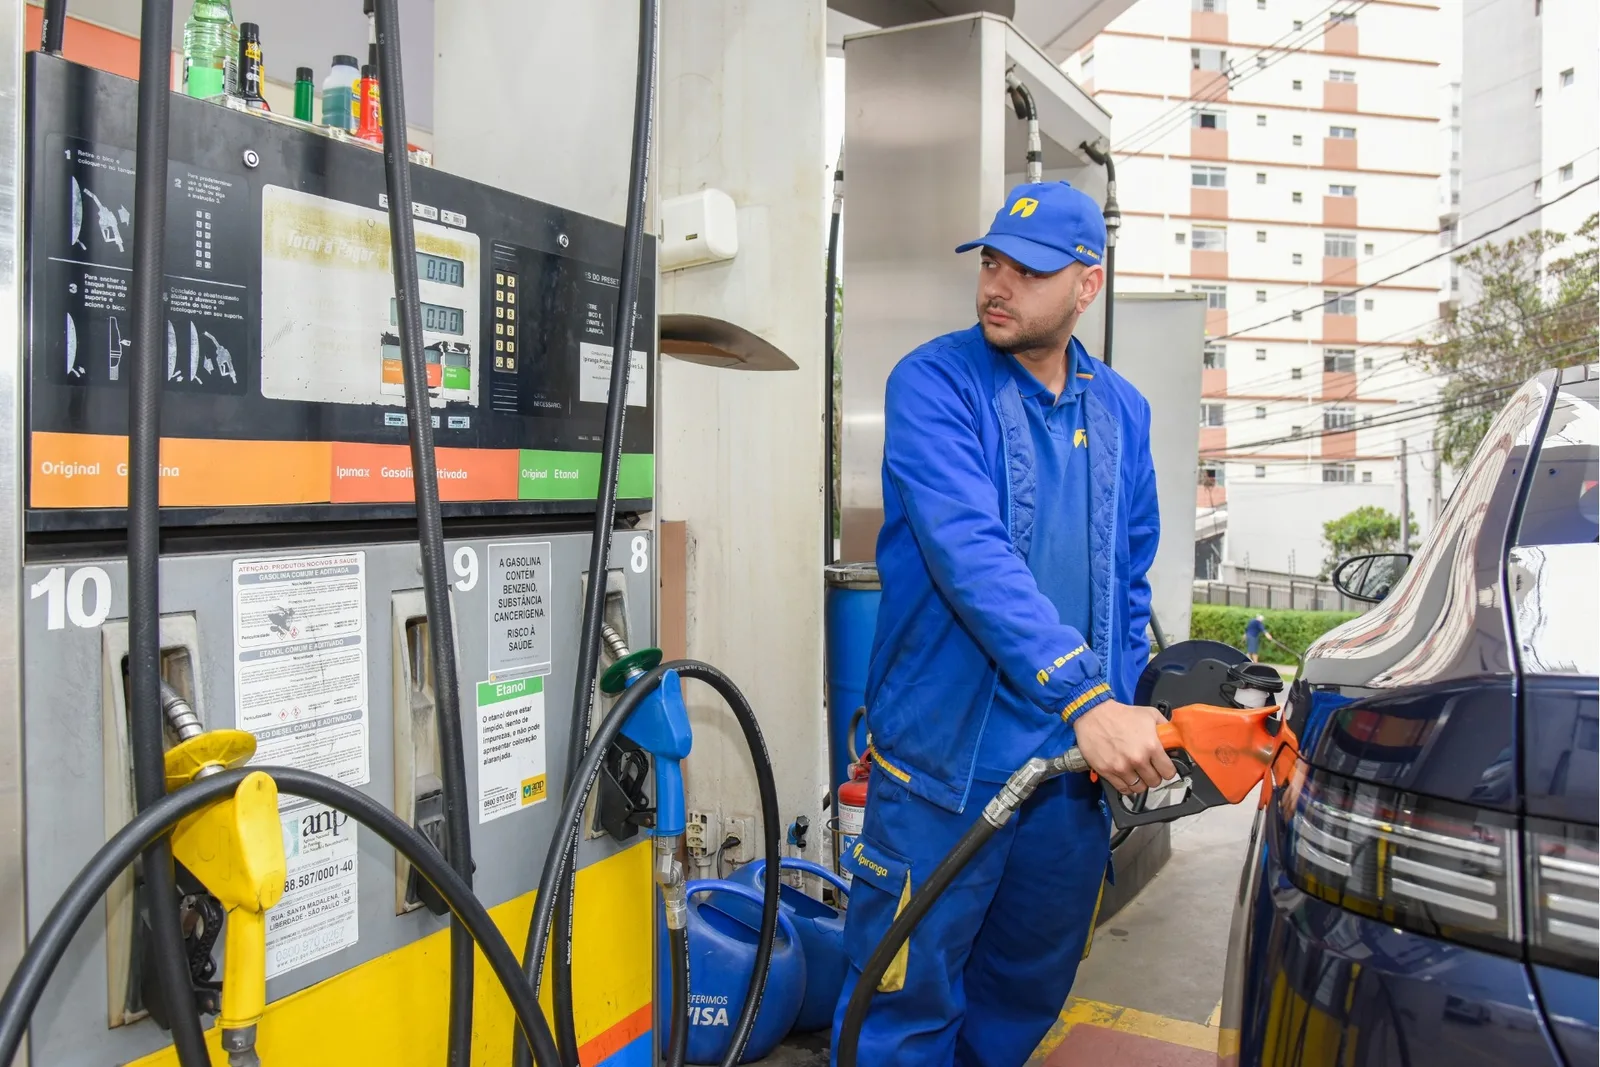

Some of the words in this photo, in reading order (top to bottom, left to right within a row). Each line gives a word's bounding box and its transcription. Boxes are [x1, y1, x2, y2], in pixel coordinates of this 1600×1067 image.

[64, 150, 70, 160] 1
[174, 178, 182, 188] 2
[427, 260, 458, 284] 0.00
[69, 283, 78, 294] 3
[426, 308, 458, 332] 0.00
[41, 461, 100, 478] Original
[336, 466, 370, 480] Ipimax
[381, 466, 414, 478] Gasoli
[437, 467, 468, 480] itivada
[522, 468, 548, 480] Original
[554, 468, 579, 479] Etanol
[631, 536, 648, 574] 8
[499, 558, 504, 568] A
[506, 556, 542, 568] GASOLINA
[258, 572, 290, 581] GASOLINA
[292, 570, 314, 578] COMUM
[453, 546, 478, 592] 9
[506, 568, 535, 580] CONTÉM
[31, 566, 112, 630] 10
[498, 594, 542, 608] SUBSTÂNCIA
[508, 628, 528, 638] RISCO
[530, 624, 536, 636] À
[260, 648, 284, 657] ETANOL
[285, 644, 308, 654] COMUM
[508, 638, 534, 651] SAÚDE.
[496, 680, 526, 697] Etanol
[488, 712, 504, 722] etanol
[506, 710, 518, 718] deve
[519, 706, 532, 714] estar
[272, 727, 292, 738] DIESEL
[517, 727, 527, 735] não
[528, 723, 540, 733] pode
[483, 742, 512, 755] apresentar
[512, 734, 538, 746] coloração
[532, 780, 544, 790] anp
[302, 810, 348, 836] anp
[270, 914, 304, 931] LIBERDADE
[320, 900, 340, 912] PAULO
[286, 905, 306, 916] SANTA
[690, 994, 728, 1005] FERIMOS
